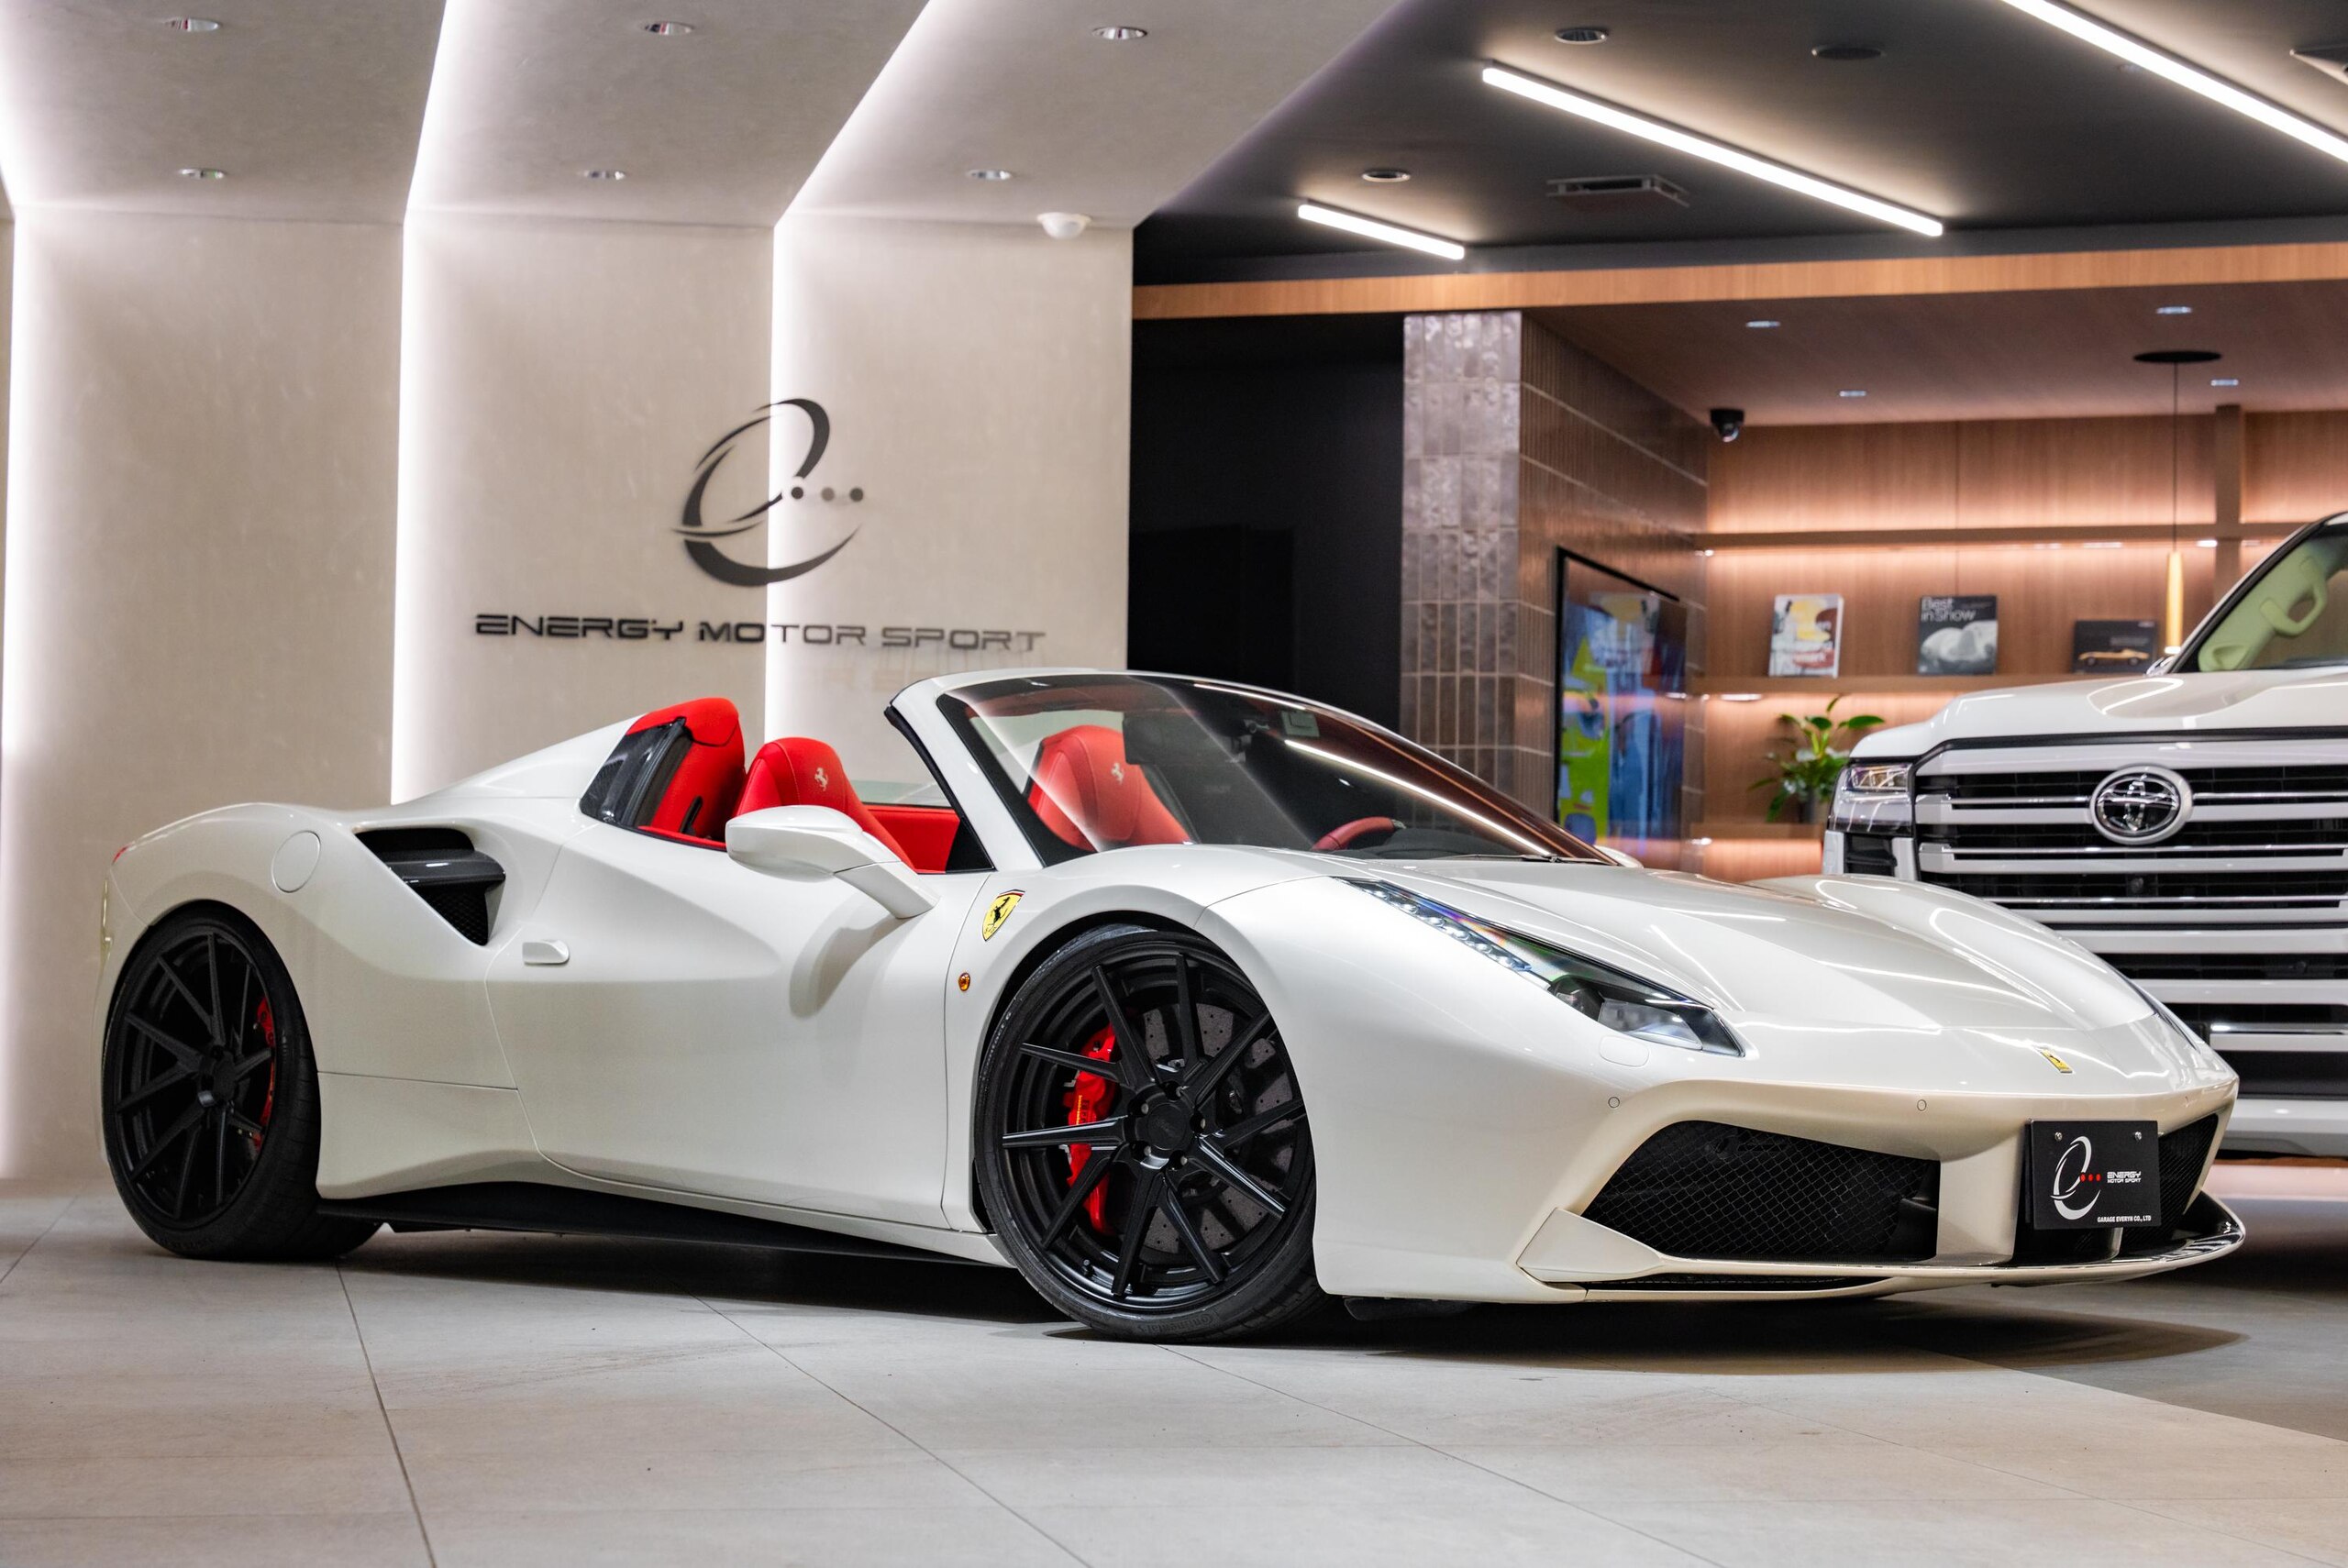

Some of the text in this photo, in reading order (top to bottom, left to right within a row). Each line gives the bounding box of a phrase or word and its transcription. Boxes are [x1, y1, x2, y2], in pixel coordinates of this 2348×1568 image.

[475, 613, 1047, 652] ENERGY MOTOR SPORT
[2107, 1171, 2142, 1179] ENERGY
